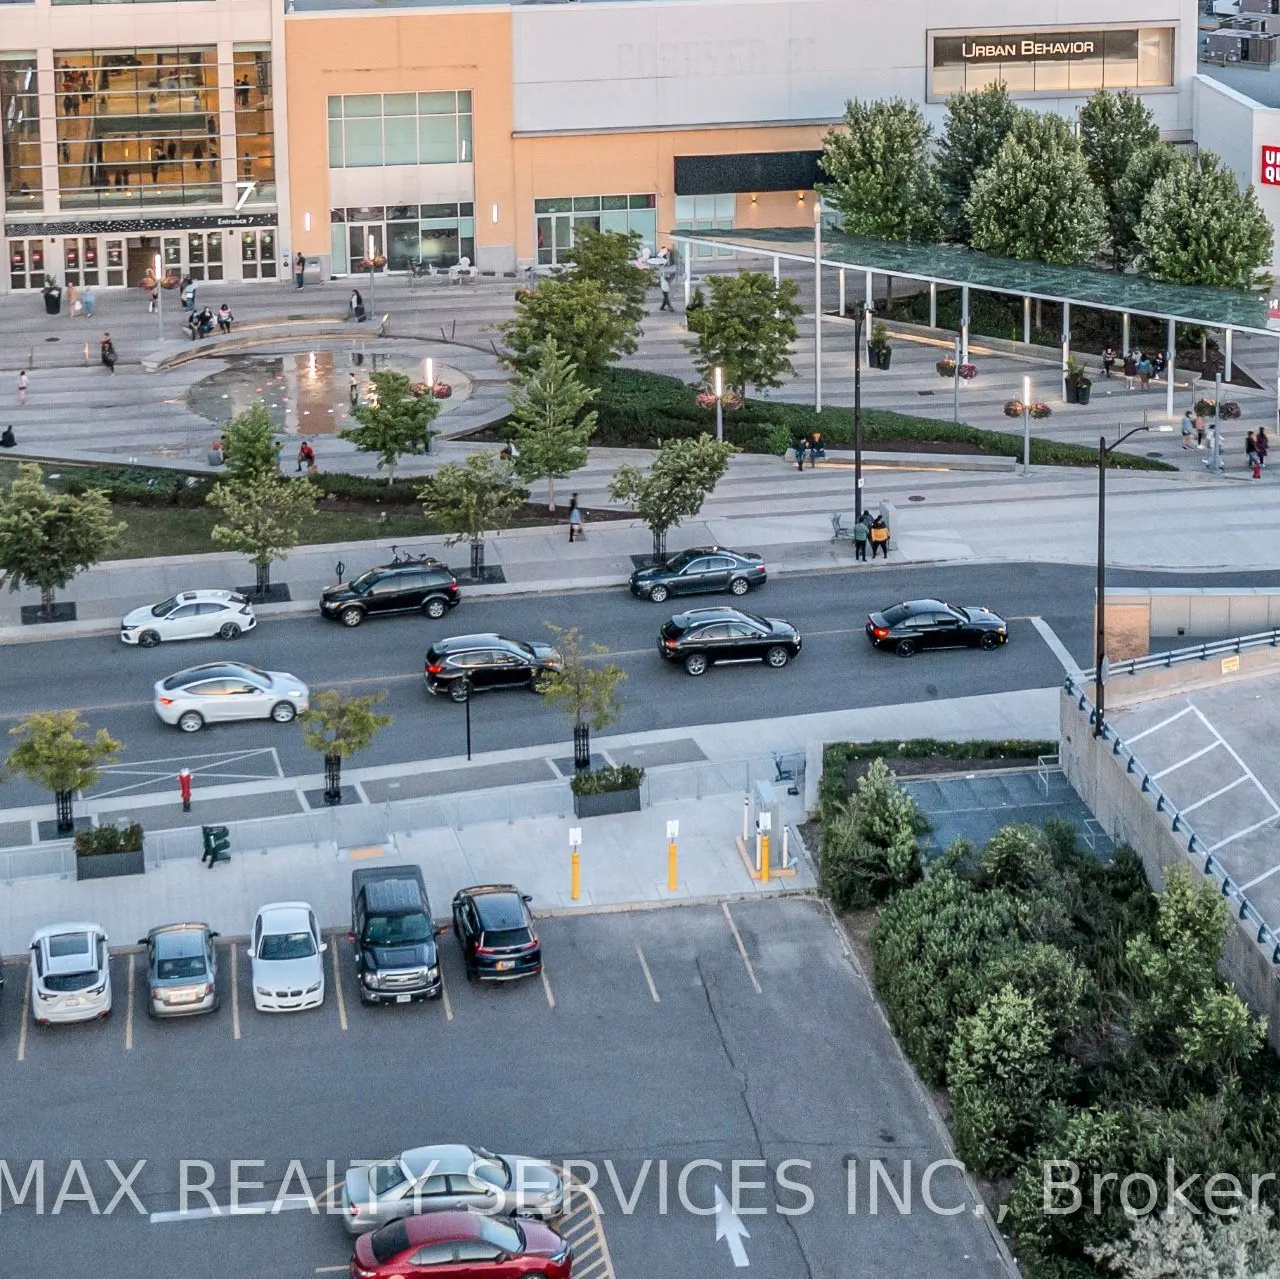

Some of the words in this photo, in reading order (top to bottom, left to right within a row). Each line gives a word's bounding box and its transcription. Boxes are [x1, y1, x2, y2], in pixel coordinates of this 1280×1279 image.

[962, 42, 1017, 58] URBAN
[1021, 40, 1094, 56] BEHAVIOR
[235, 182, 258, 211] 7
[217, 217, 247, 225] Entrance
